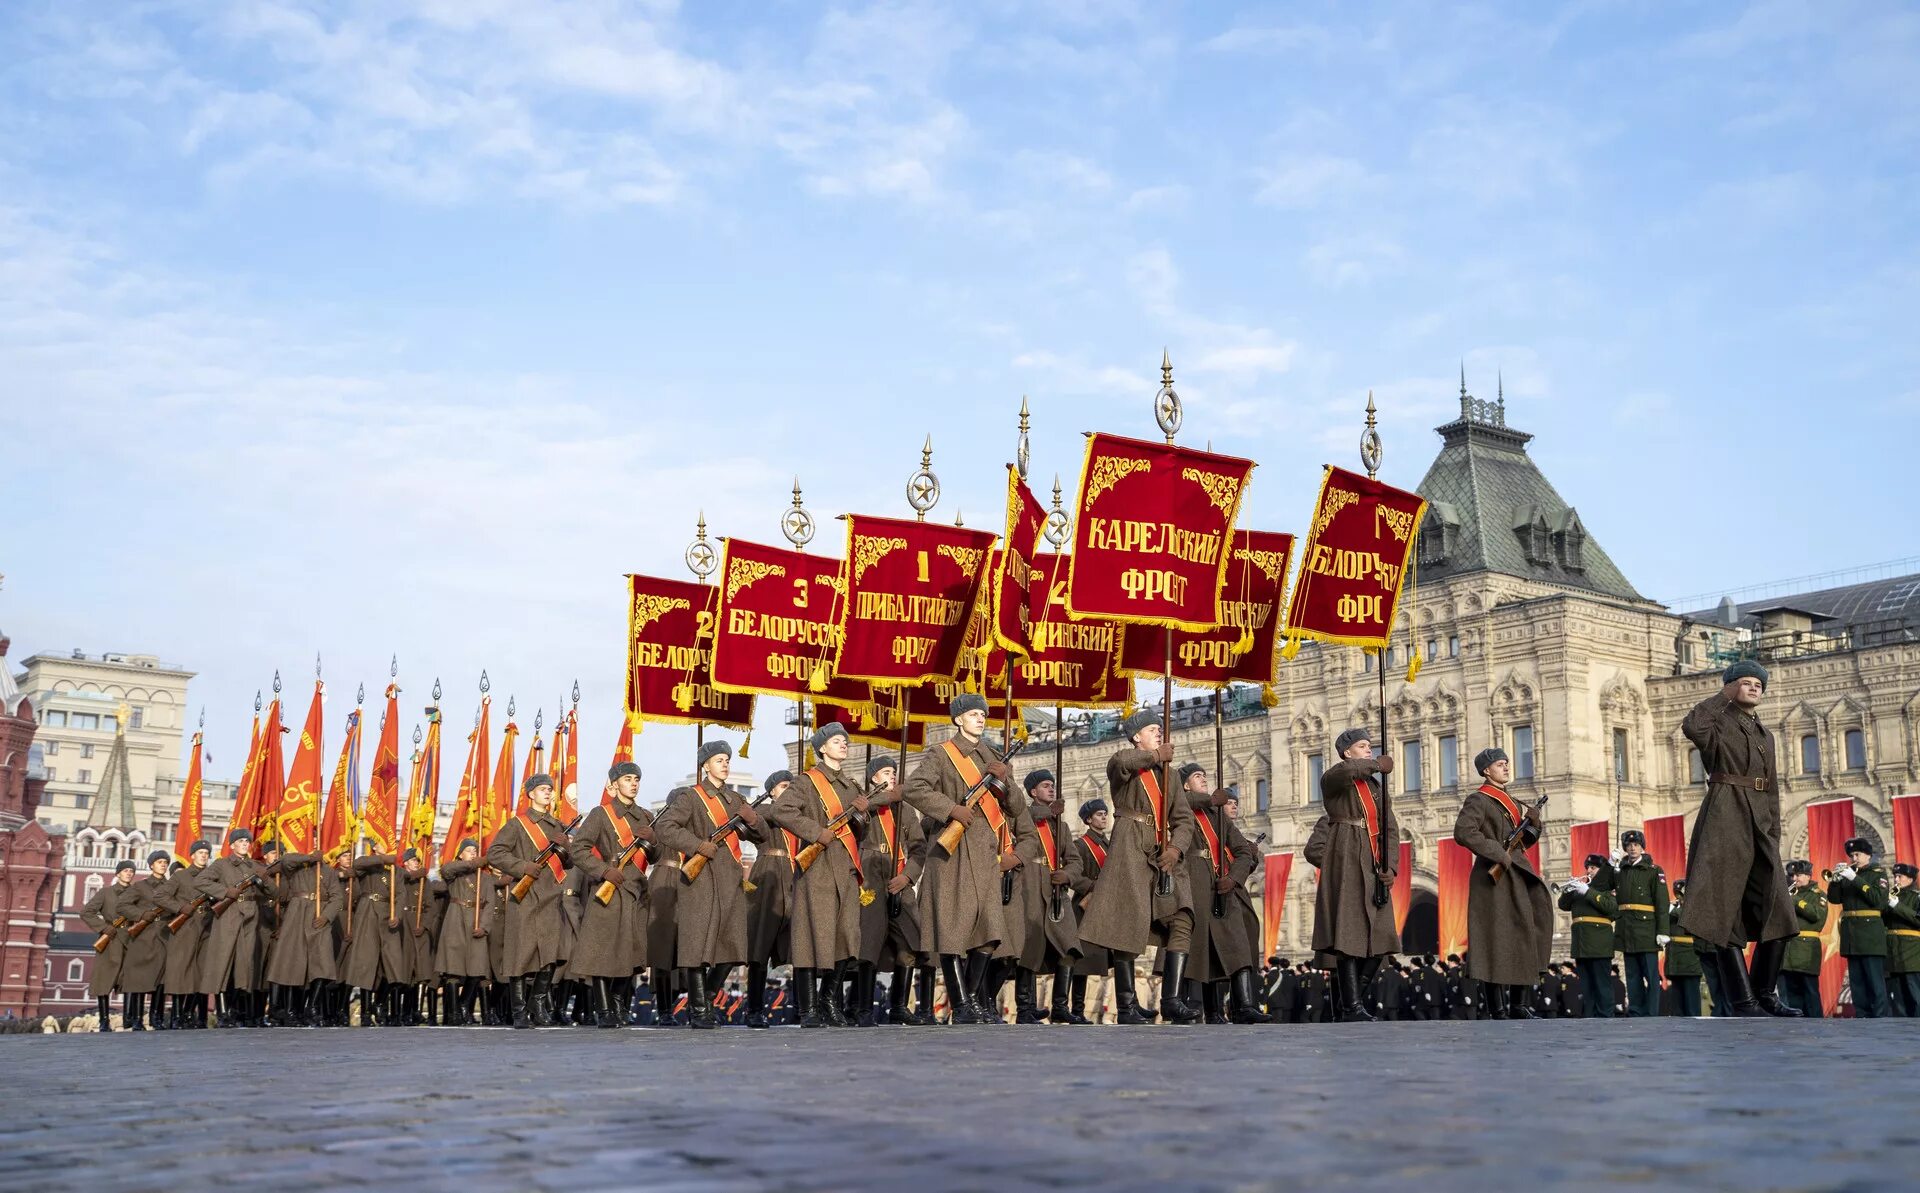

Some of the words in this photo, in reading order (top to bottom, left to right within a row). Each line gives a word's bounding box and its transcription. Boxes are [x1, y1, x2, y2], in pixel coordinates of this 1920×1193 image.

[916, 550, 930, 583] 1
[793, 578, 808, 608] 3
[696, 610, 713, 638] 2
[1021, 660, 1084, 688] ФРОНТ
